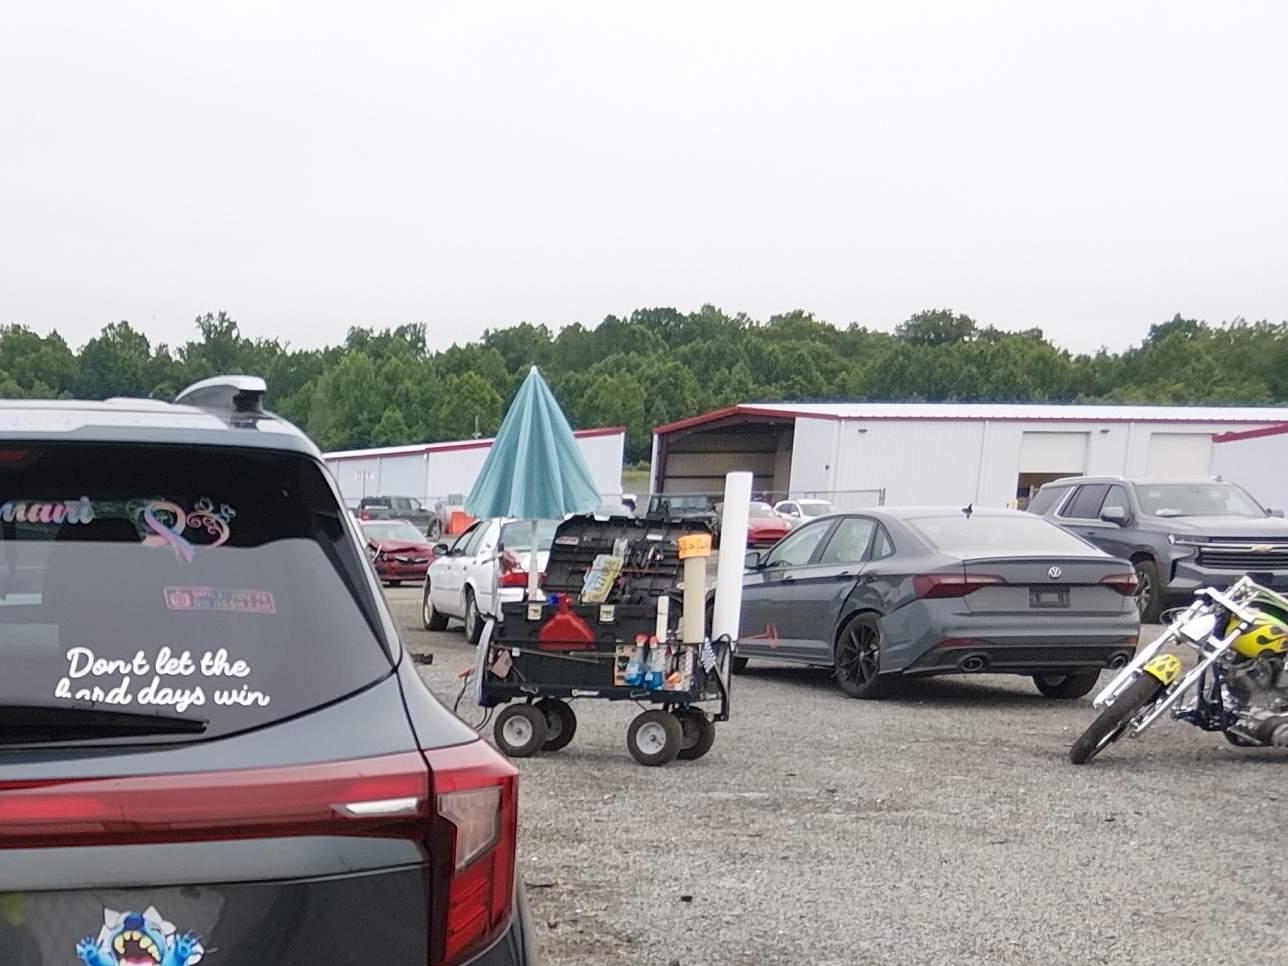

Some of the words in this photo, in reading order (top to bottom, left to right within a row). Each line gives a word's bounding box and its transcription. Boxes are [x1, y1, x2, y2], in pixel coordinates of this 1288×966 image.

[155, 646, 196, 676] let
[200, 648, 251, 677] the
[137, 676, 206, 713] days
[214, 684, 271, 706] win
